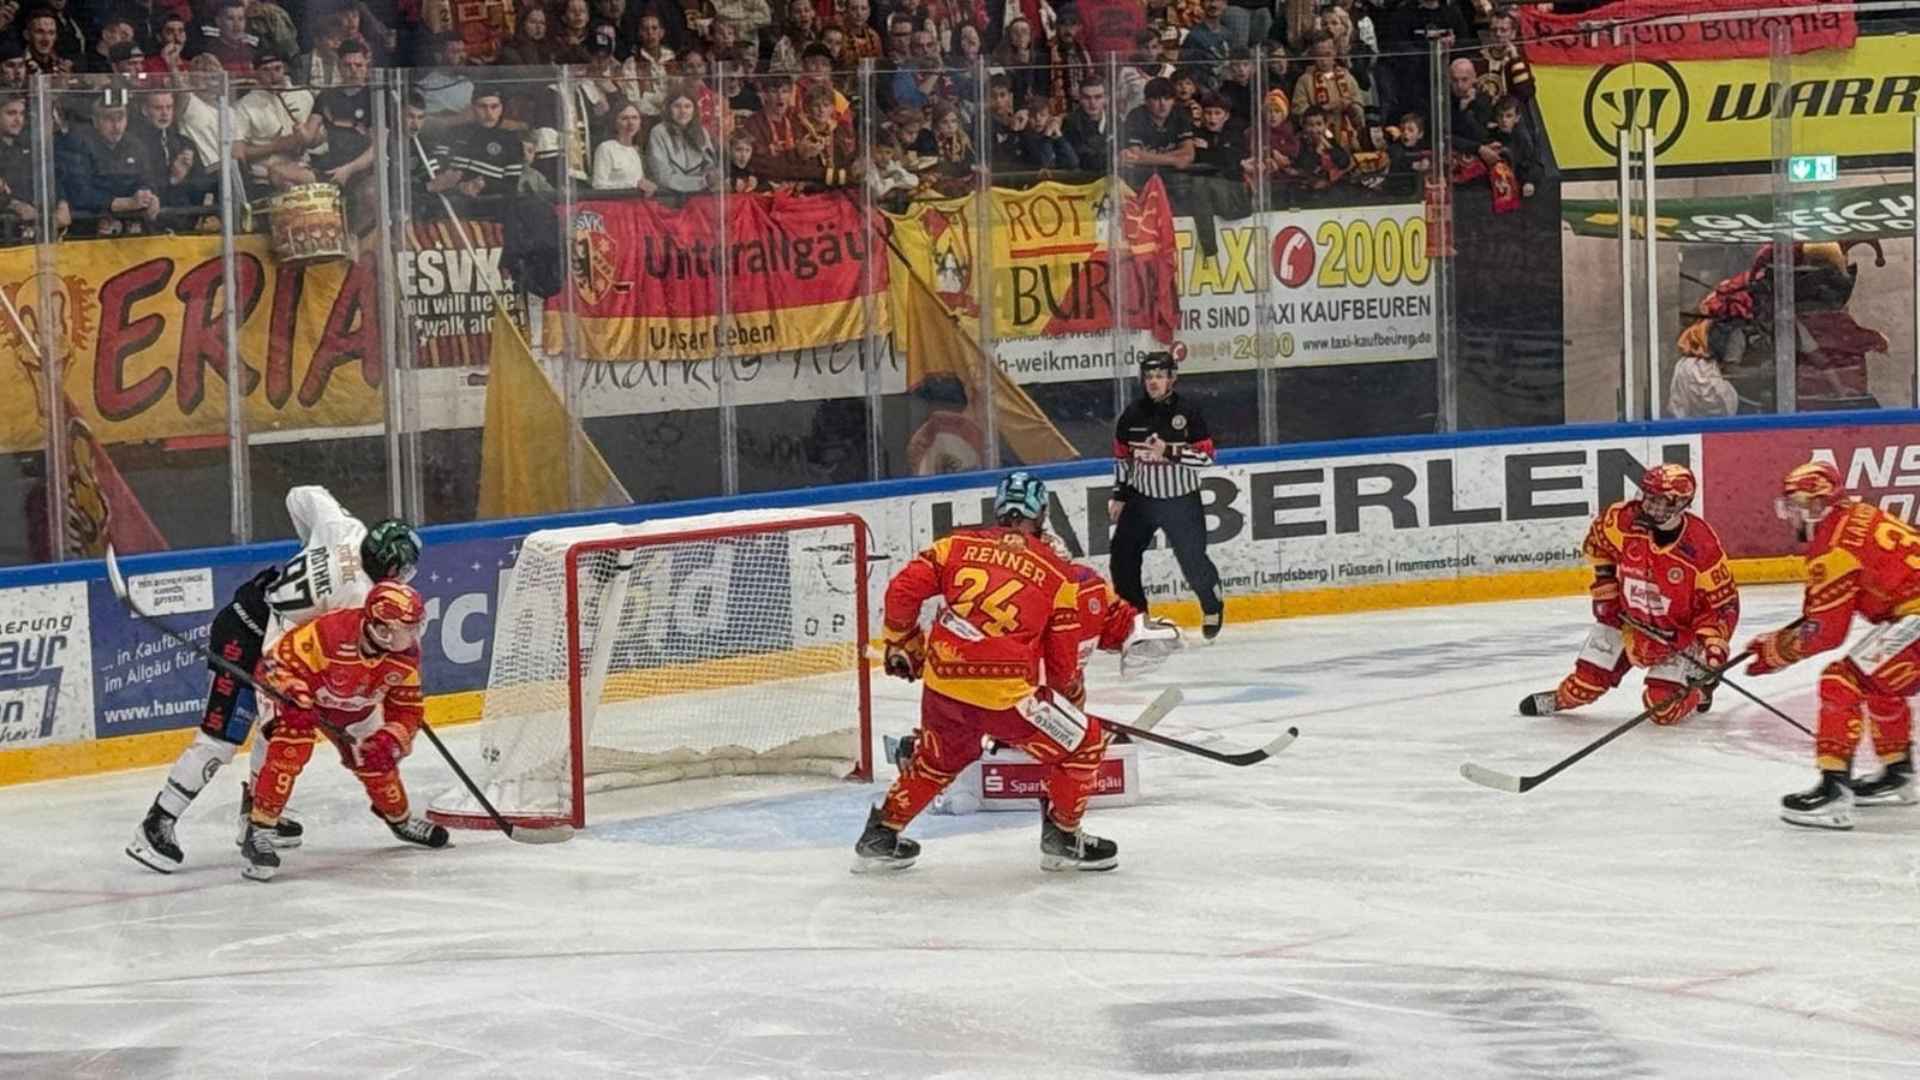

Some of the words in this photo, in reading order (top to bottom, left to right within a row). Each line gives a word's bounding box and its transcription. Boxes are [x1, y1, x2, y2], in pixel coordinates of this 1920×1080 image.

[1316, 217, 1432, 288] 2000
[397, 247, 504, 295] ESVK
[432, 294, 466, 315] will
[1207, 306, 1250, 329] SIND
[1301, 296, 1431, 323] KAUFBEUREN
[962, 546, 1047, 588] RENNER
[1261, 567, 1328, 584] Landsberg
[1338, 563, 1384, 577] Füssen
[1395, 554, 1477, 574] Immenstadt
[951, 566, 1026, 638] 24
[0, 615, 73, 636] erung
[104, 675, 123, 693] im
[127, 664, 171, 691] Allgäu
[1009, 779, 1049, 794] Spark
